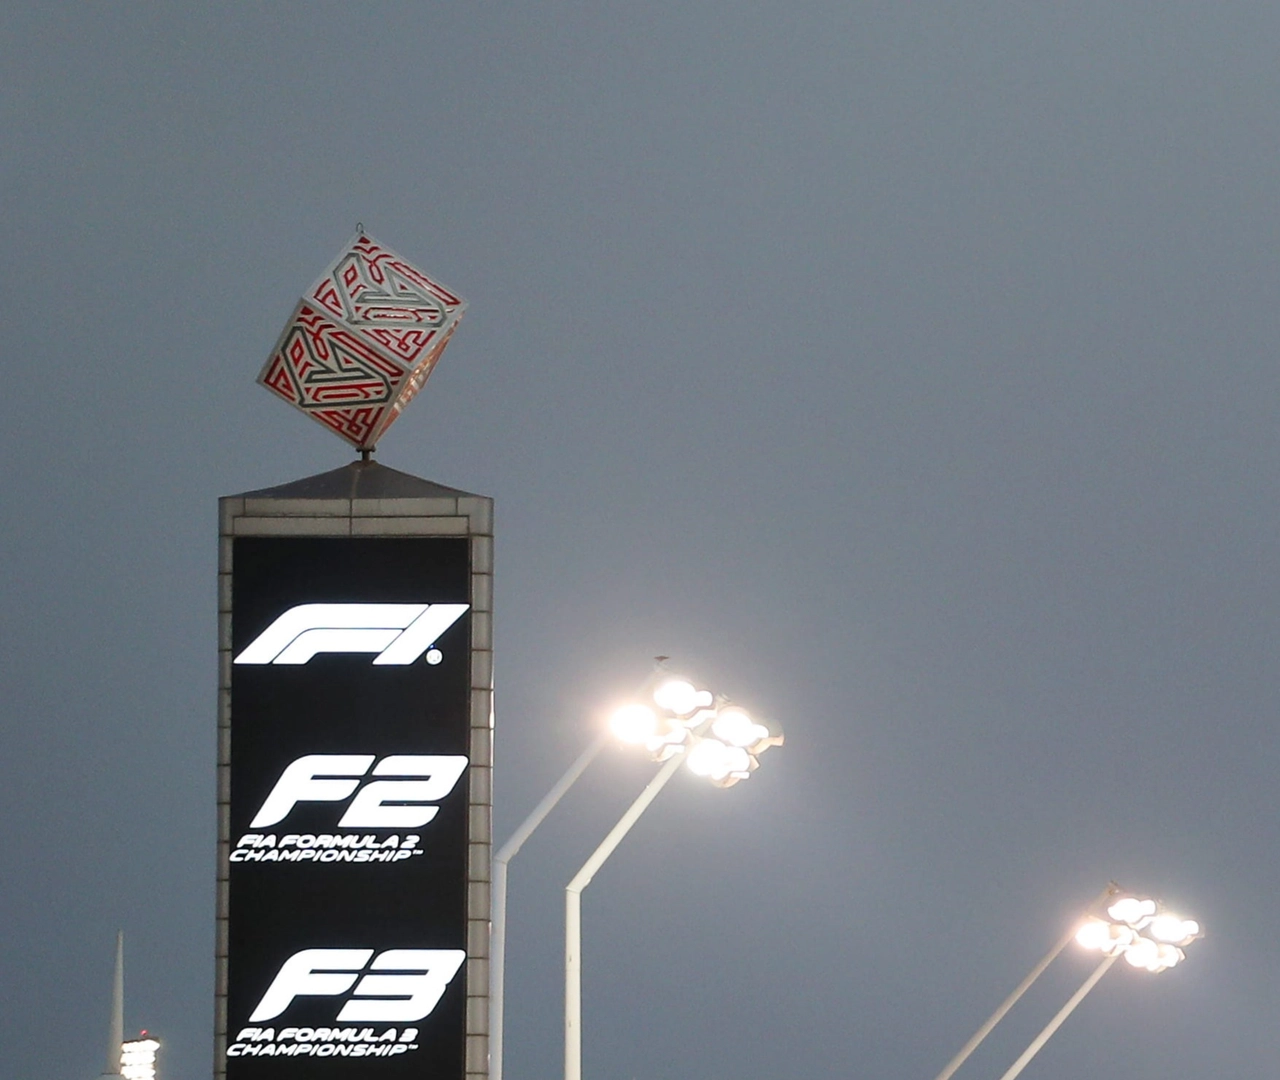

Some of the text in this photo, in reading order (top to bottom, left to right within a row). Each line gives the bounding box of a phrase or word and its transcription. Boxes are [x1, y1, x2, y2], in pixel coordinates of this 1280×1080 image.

[249, 754, 469, 828] F2
[237, 834, 420, 849] FIA FORMULA 2
[249, 949, 466, 1022] F3
[236, 1028, 418, 1042] FIA FORMULA 3
